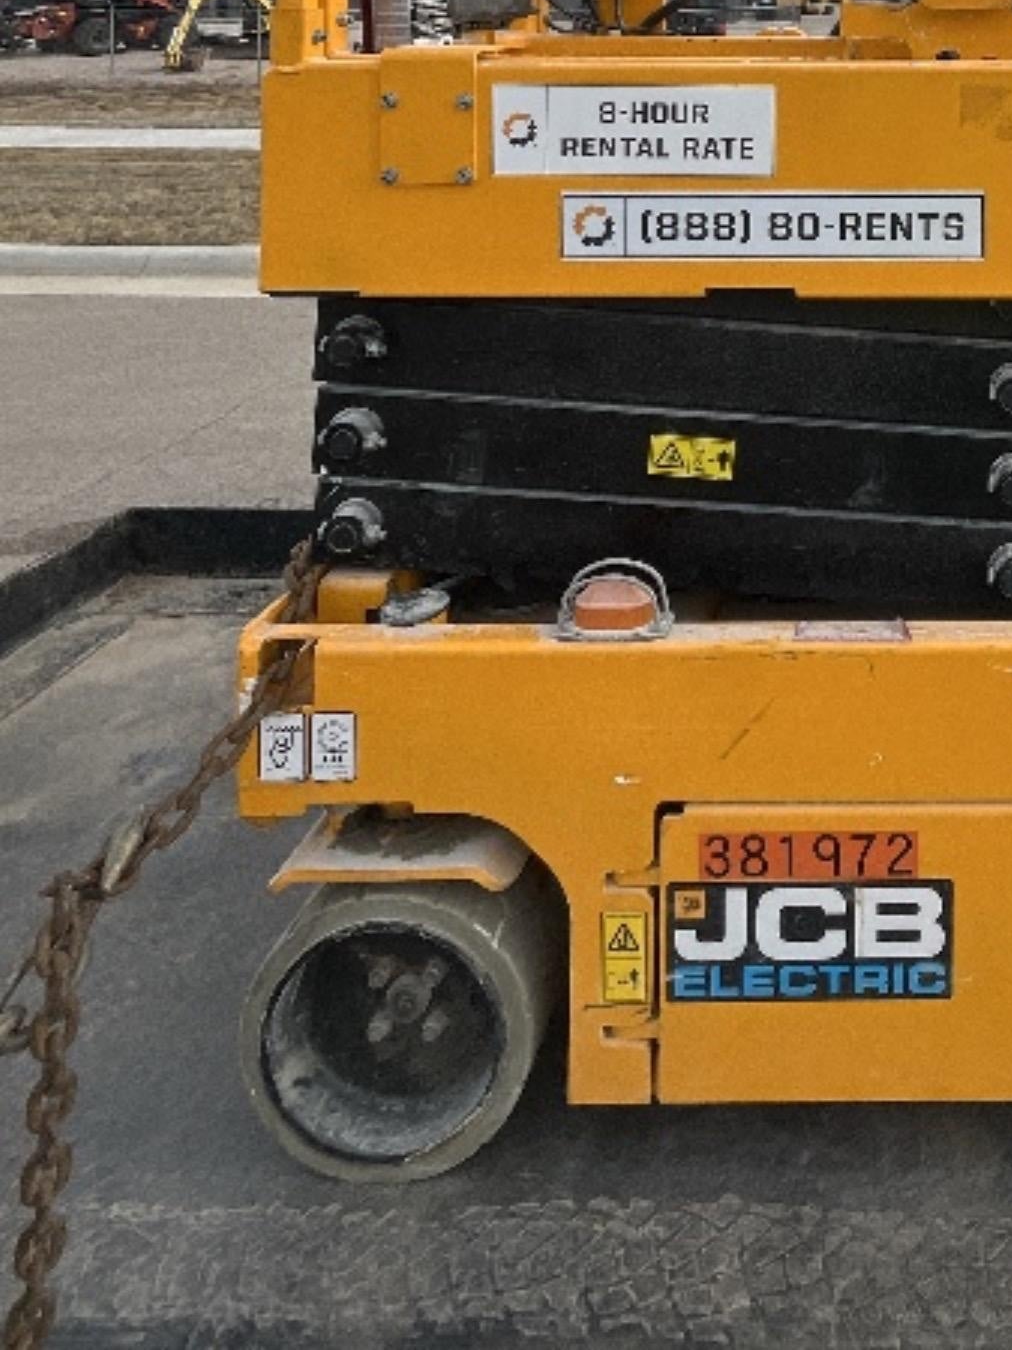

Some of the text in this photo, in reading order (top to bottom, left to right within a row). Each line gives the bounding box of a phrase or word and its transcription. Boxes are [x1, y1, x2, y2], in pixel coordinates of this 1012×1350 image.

[599, 101, 710, 125] 8-HOUR
[560, 136, 755, 161] RENTAL RATE
[640, 209, 966, 244] (888) 80-RENTS
[703, 833, 914, 877] 381972
[673, 886, 947, 961] JCB
[672, 963, 947, 998] ELECTRIC
